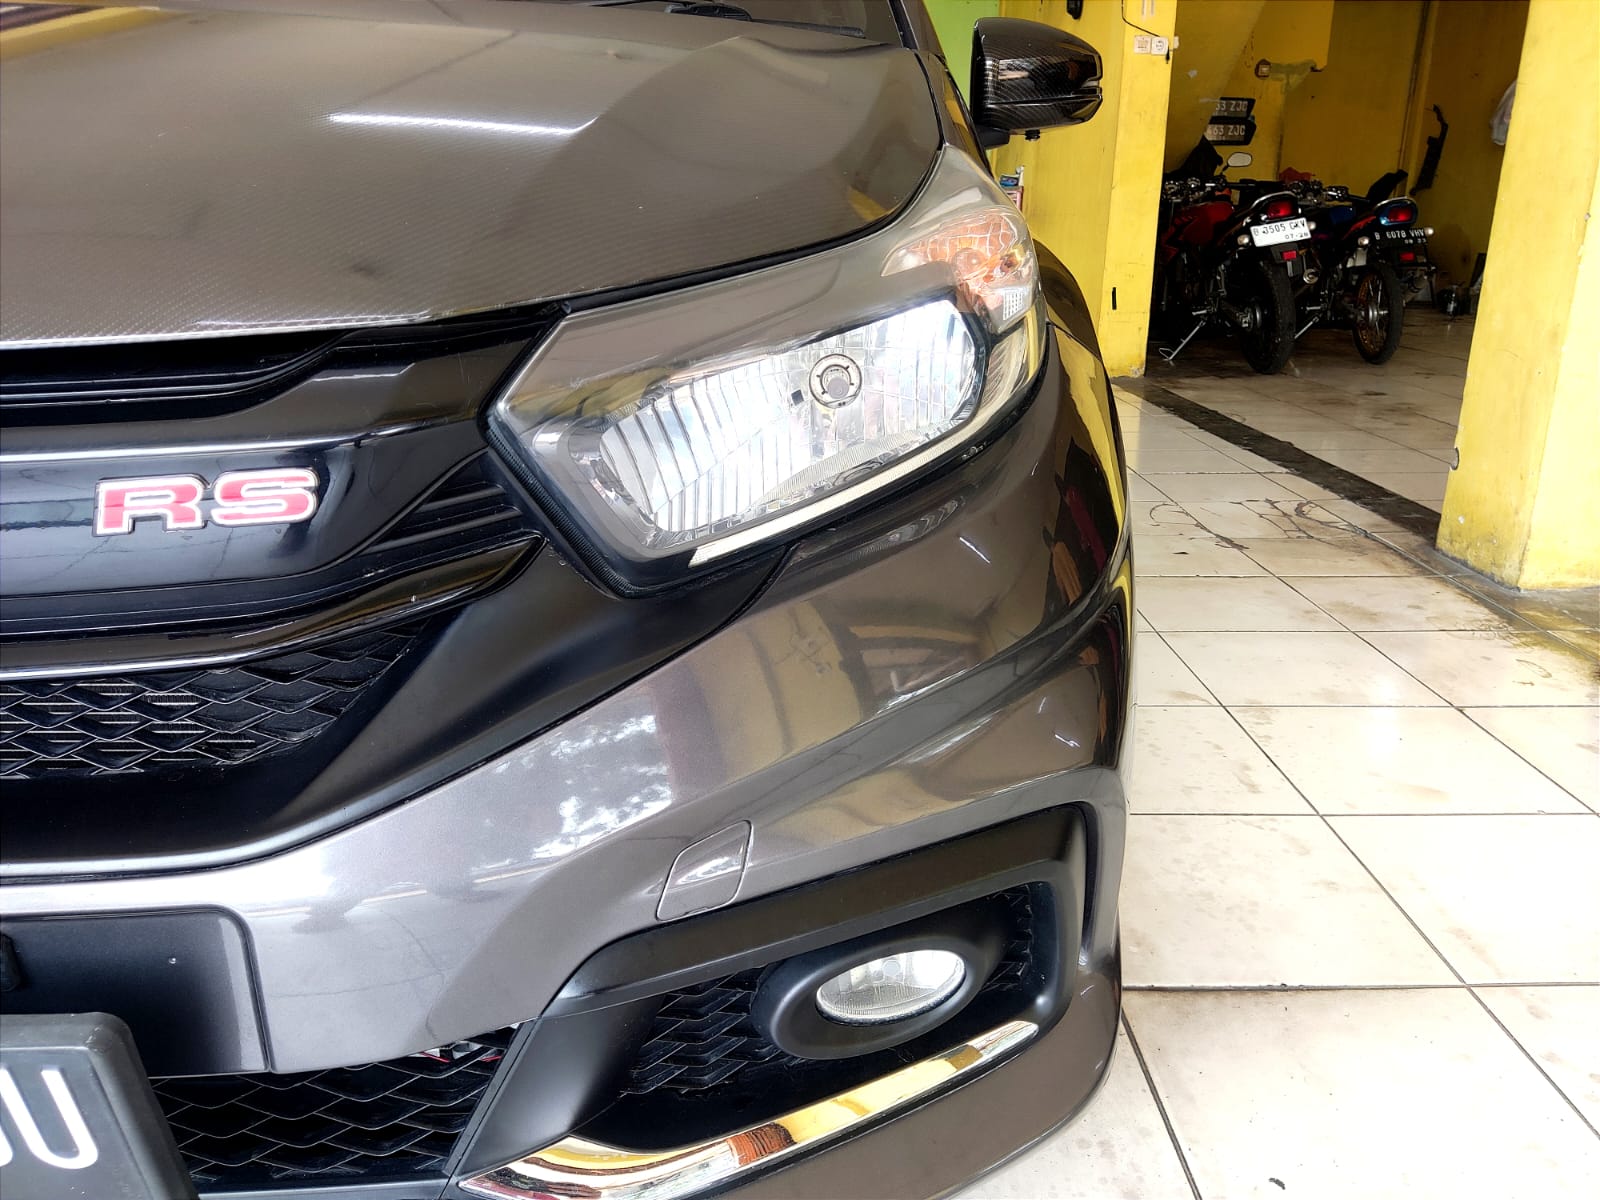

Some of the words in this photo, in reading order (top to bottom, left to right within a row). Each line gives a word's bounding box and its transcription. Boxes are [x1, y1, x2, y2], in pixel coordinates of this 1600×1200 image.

[1252, 227, 1259, 237] B
[1374, 231, 1381, 241] B
[93, 467, 320, 537] RS
[0, 1068, 98, 1170] U
